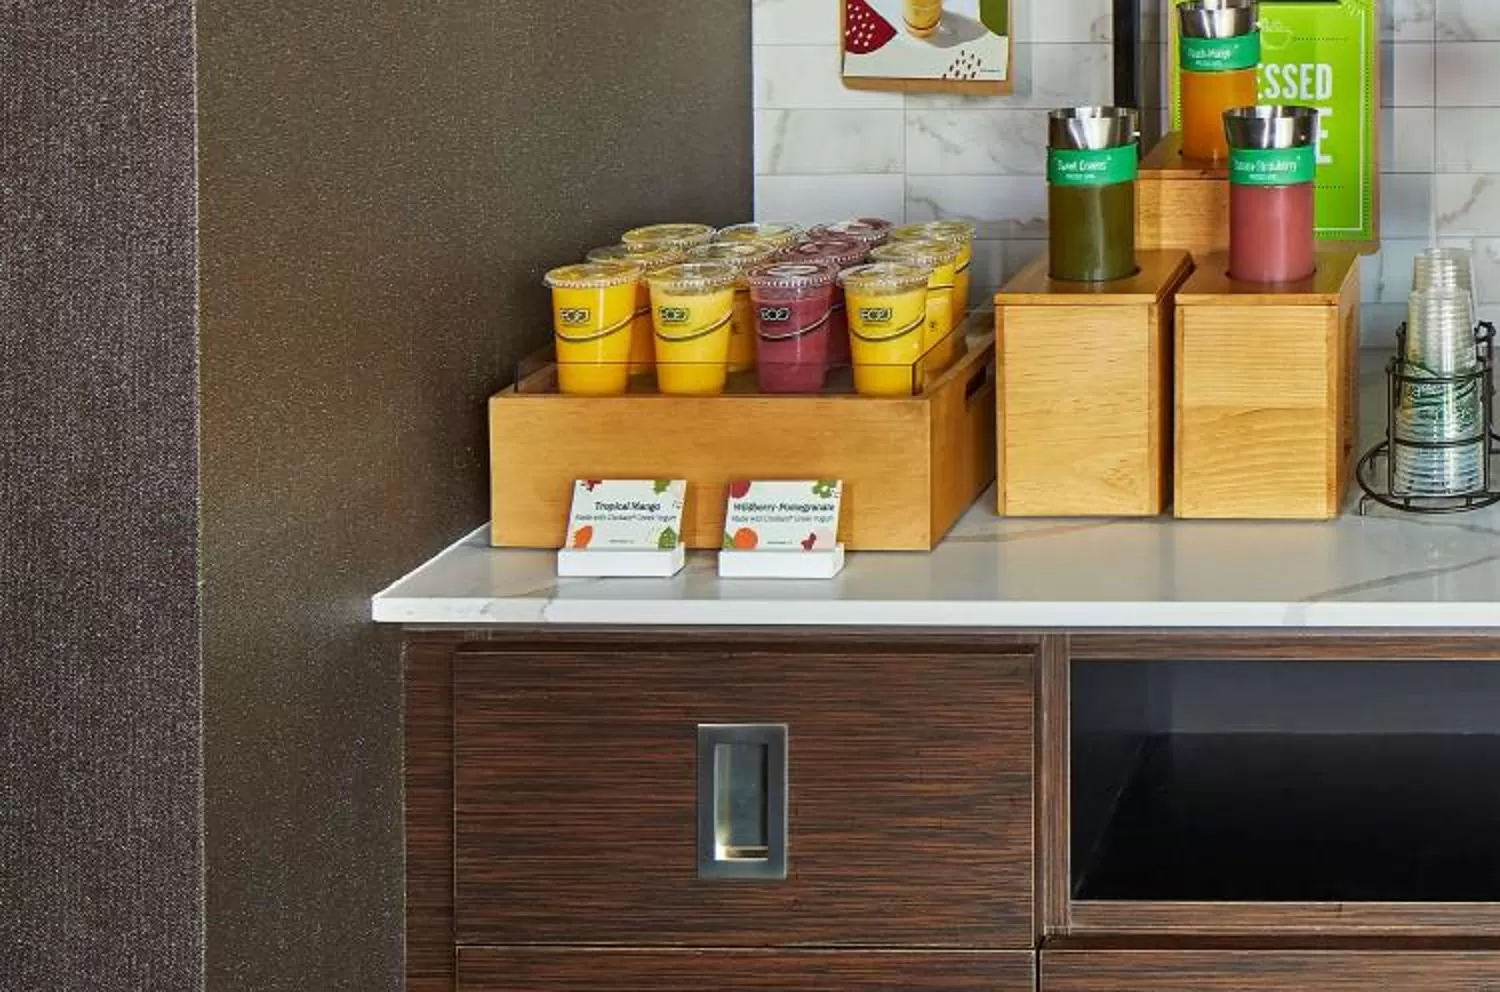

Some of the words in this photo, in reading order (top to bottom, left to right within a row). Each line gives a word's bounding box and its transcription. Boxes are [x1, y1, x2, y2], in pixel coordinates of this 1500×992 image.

[1256, 63, 1333, 100] SSED
[595, 501, 630, 512] Tropical
[632, 501, 661, 512] Mango
